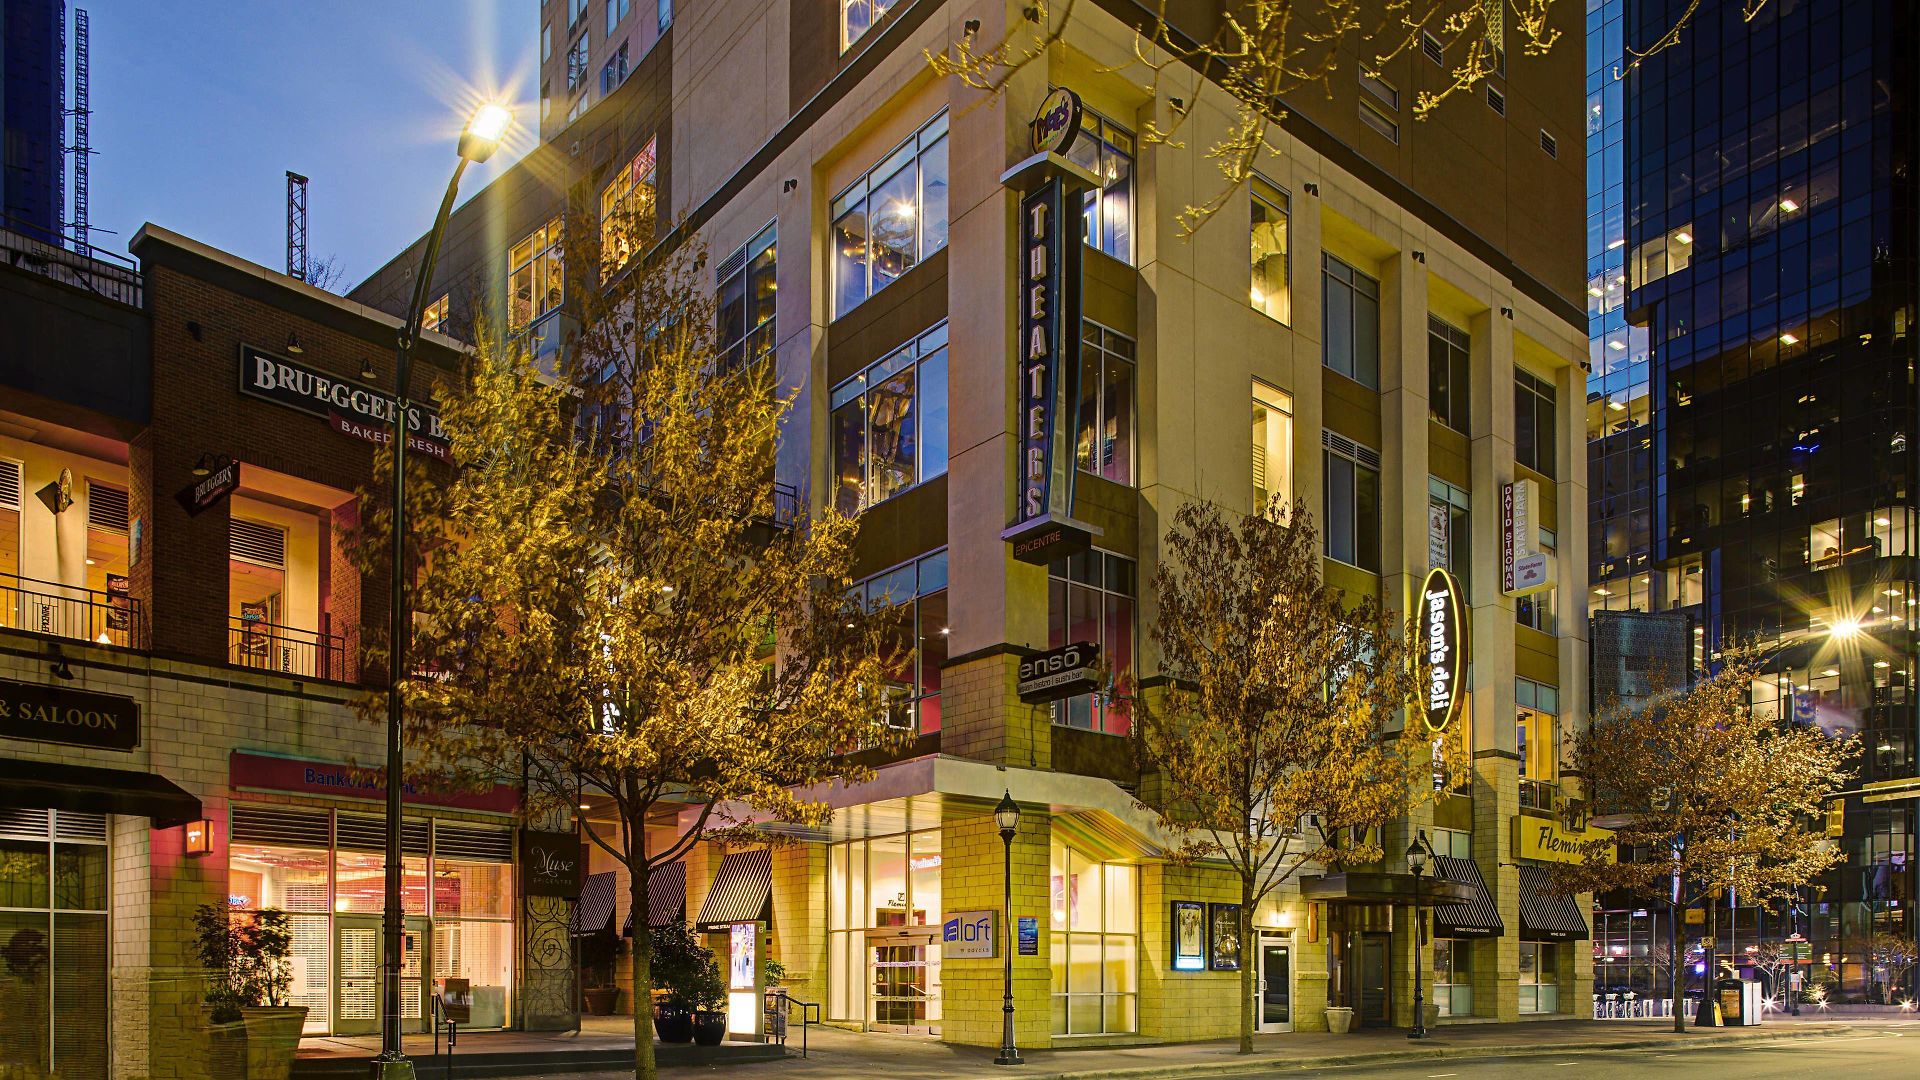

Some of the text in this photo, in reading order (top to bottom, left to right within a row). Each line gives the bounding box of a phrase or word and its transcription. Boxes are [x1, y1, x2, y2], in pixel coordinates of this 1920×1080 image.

[1028, 202, 1048, 518] THEATERS
[341, 419, 445, 458] BAKED RESH
[1505, 486, 1513, 589] DAVID STROMAN
[1426, 589, 1450, 664] Jason's
[1071, 671, 1083, 680] bar
[1430, 666, 1450, 710] deli
[19, 702, 118, 730] SALOON
[304, 768, 345, 788] Bank
[531, 846, 574, 878] Muse
[943, 916, 991, 942] aloft
